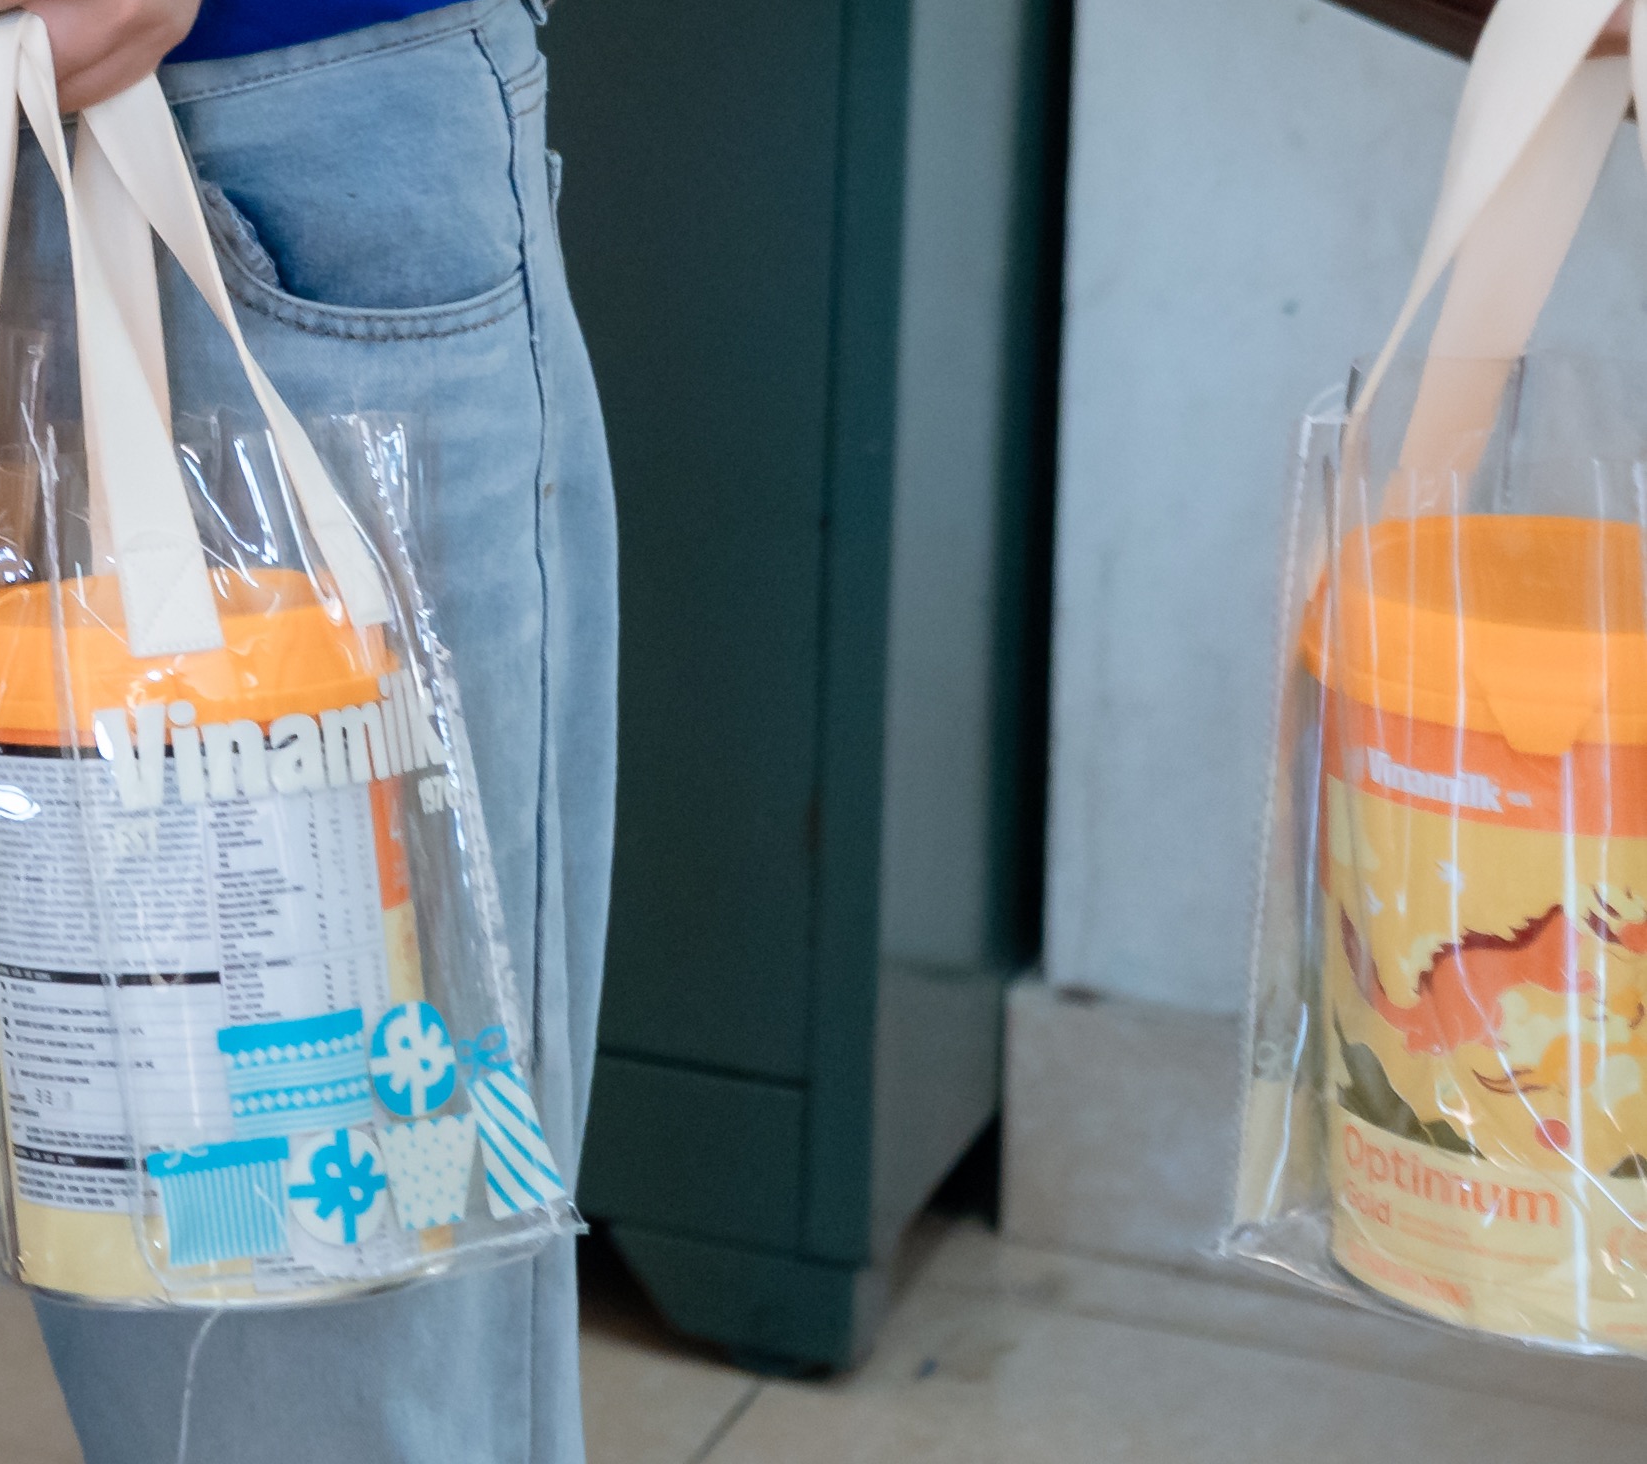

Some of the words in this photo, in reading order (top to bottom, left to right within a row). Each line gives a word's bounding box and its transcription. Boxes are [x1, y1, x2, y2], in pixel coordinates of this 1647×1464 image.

[93, 668, 450, 810] Vinamilk
[1366, 746, 1504, 814] Vinamilk
[1344, 1123, 1562, 1229] Optimum
